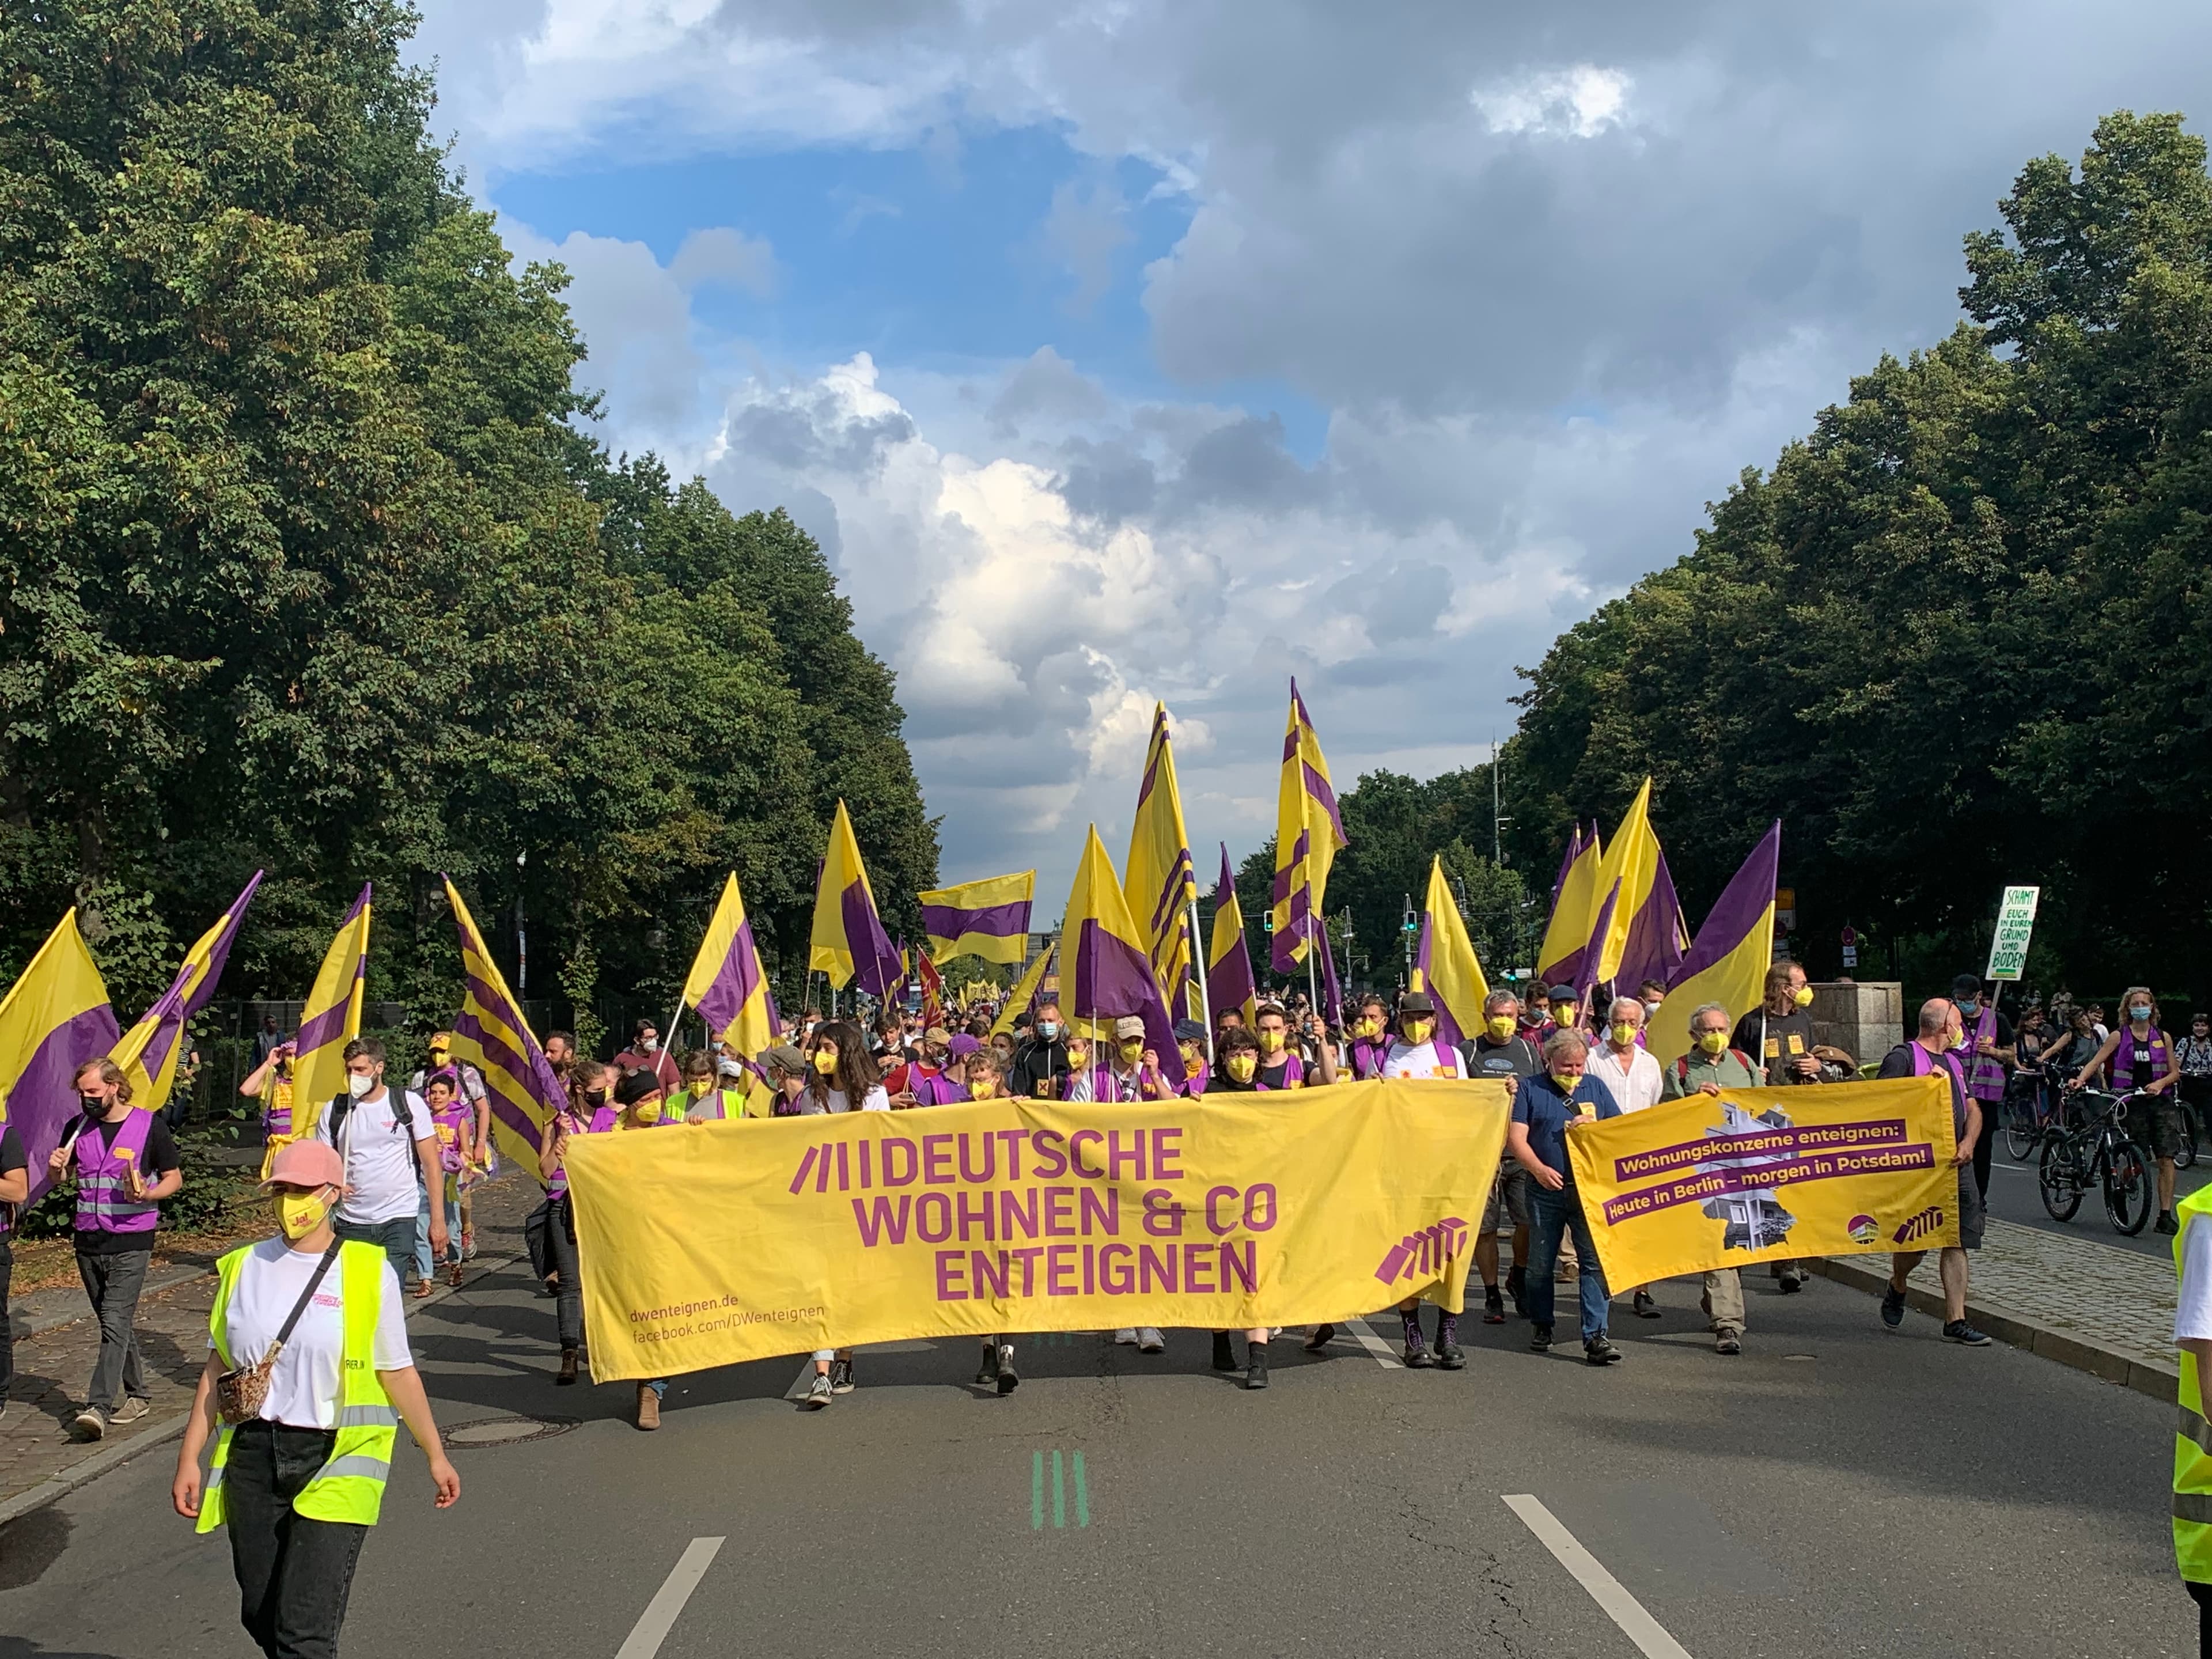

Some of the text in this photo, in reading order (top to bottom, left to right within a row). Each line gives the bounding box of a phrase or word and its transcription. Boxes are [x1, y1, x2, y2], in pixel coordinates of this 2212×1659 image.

[2006, 910, 2029, 918] EUCH
[2000, 928, 2029, 941] GRUND
[2002, 942, 2019, 950] UND
[1992, 952, 2027, 968] BODEN
[882, 1128, 1182, 1185] DEUTSCHE
[1622, 1126, 1900, 1174] Wohnungskonzerne enteignen:
[1609, 1198, 1650, 1219] Heute
[1654, 1190, 1670, 1205] in
[1674, 1177, 1724, 1199] Berlin
[1741, 1165, 1810, 1185] morgen
[1815, 1160, 1832, 1173] in
[1838, 1150, 1926, 1170] Potsdam!
[292, 1212, 308, 1226] Ja!
[851, 1184, 1276, 1246] WOHNEN & CO
[935, 1242, 1256, 1300] ENTEIGNEN
[630, 1294, 739, 1323] dwenteignen.de
[632, 1305, 825, 1344] facebook.com/DWenteignen
